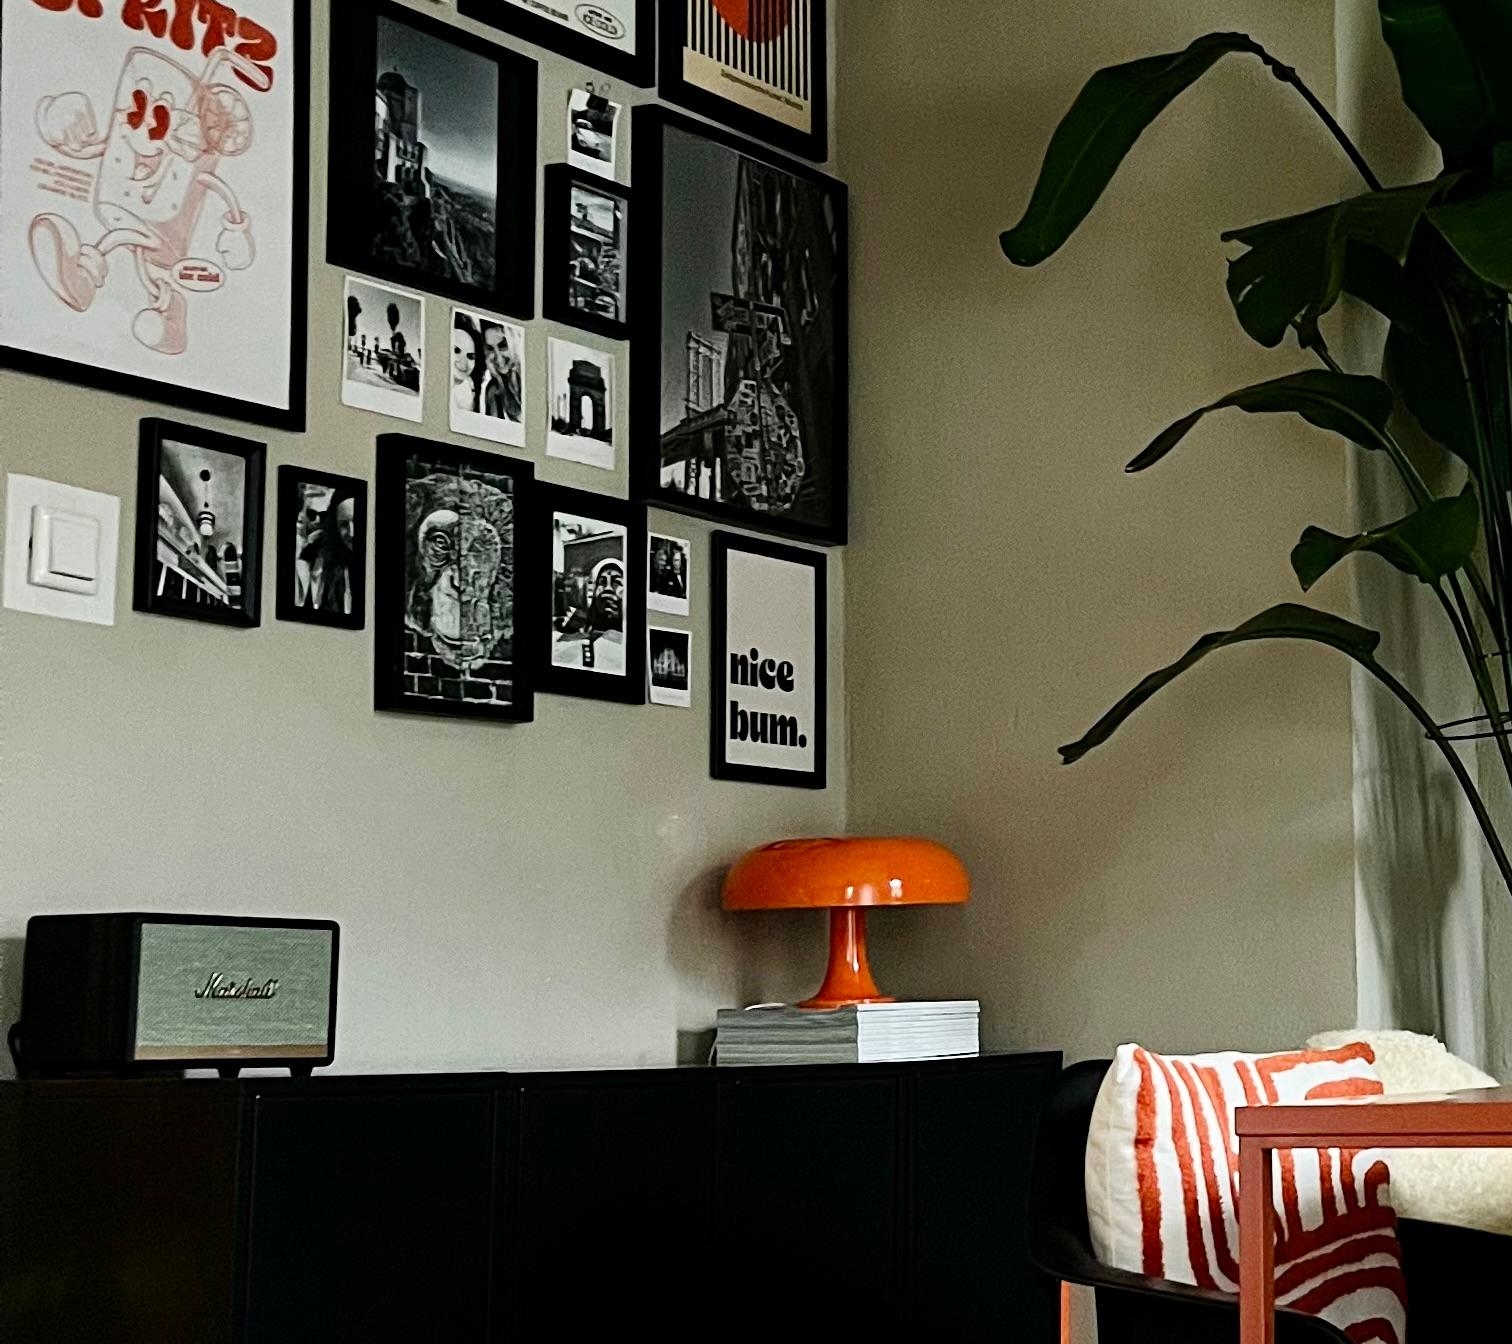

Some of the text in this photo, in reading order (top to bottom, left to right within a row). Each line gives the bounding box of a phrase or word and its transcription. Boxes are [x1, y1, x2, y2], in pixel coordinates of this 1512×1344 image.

[730, 647, 795, 693] nice
[730, 700, 807, 748] bum.
[194, 971, 280, 1000] Marshall
